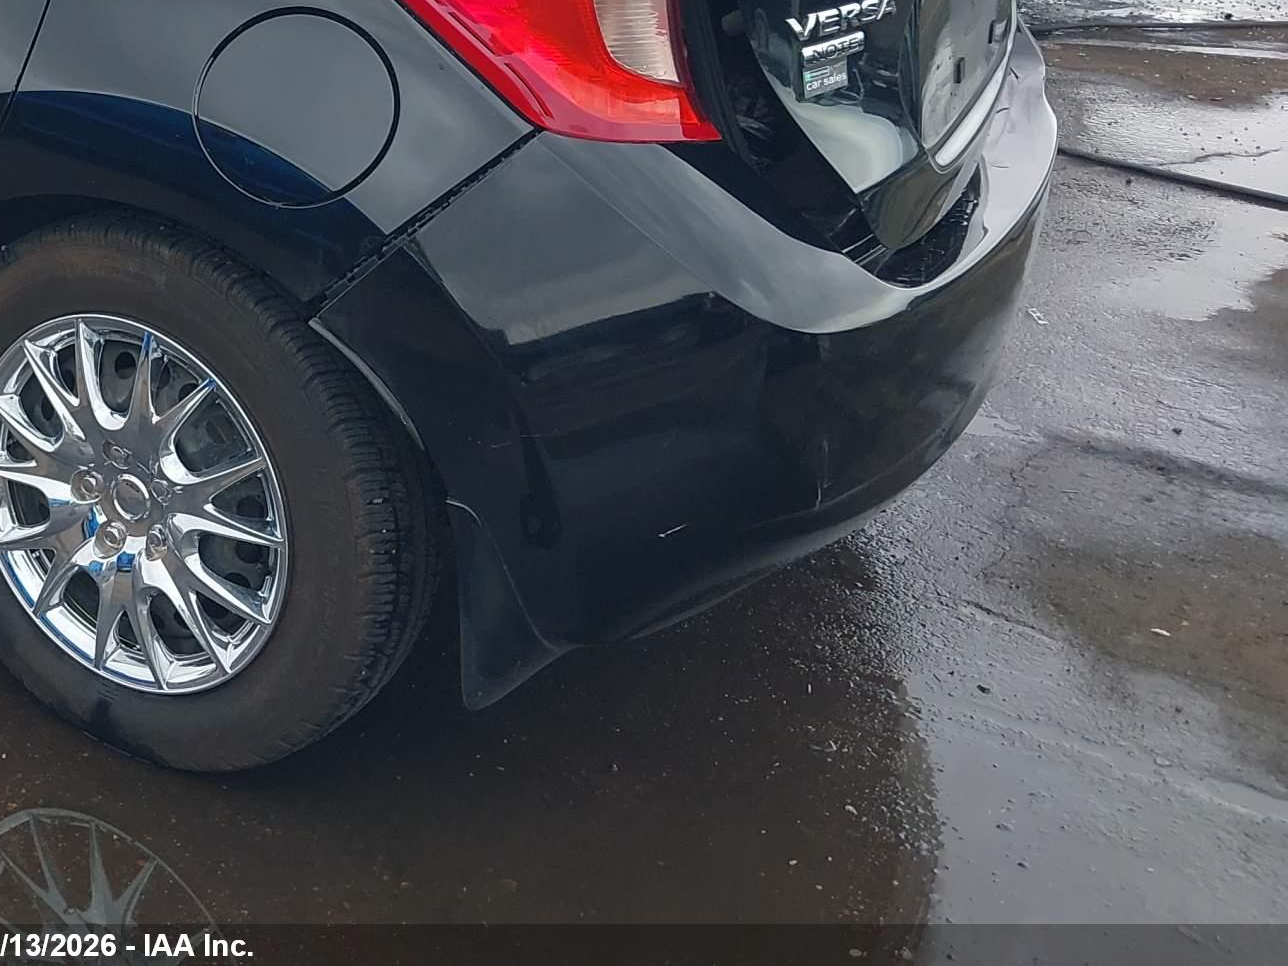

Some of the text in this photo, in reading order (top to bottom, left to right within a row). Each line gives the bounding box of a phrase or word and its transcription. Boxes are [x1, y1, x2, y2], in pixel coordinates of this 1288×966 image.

[810, 35, 862, 62] NOTE
[806, 79, 822, 91] car
[823, 72, 847, 86] sales
